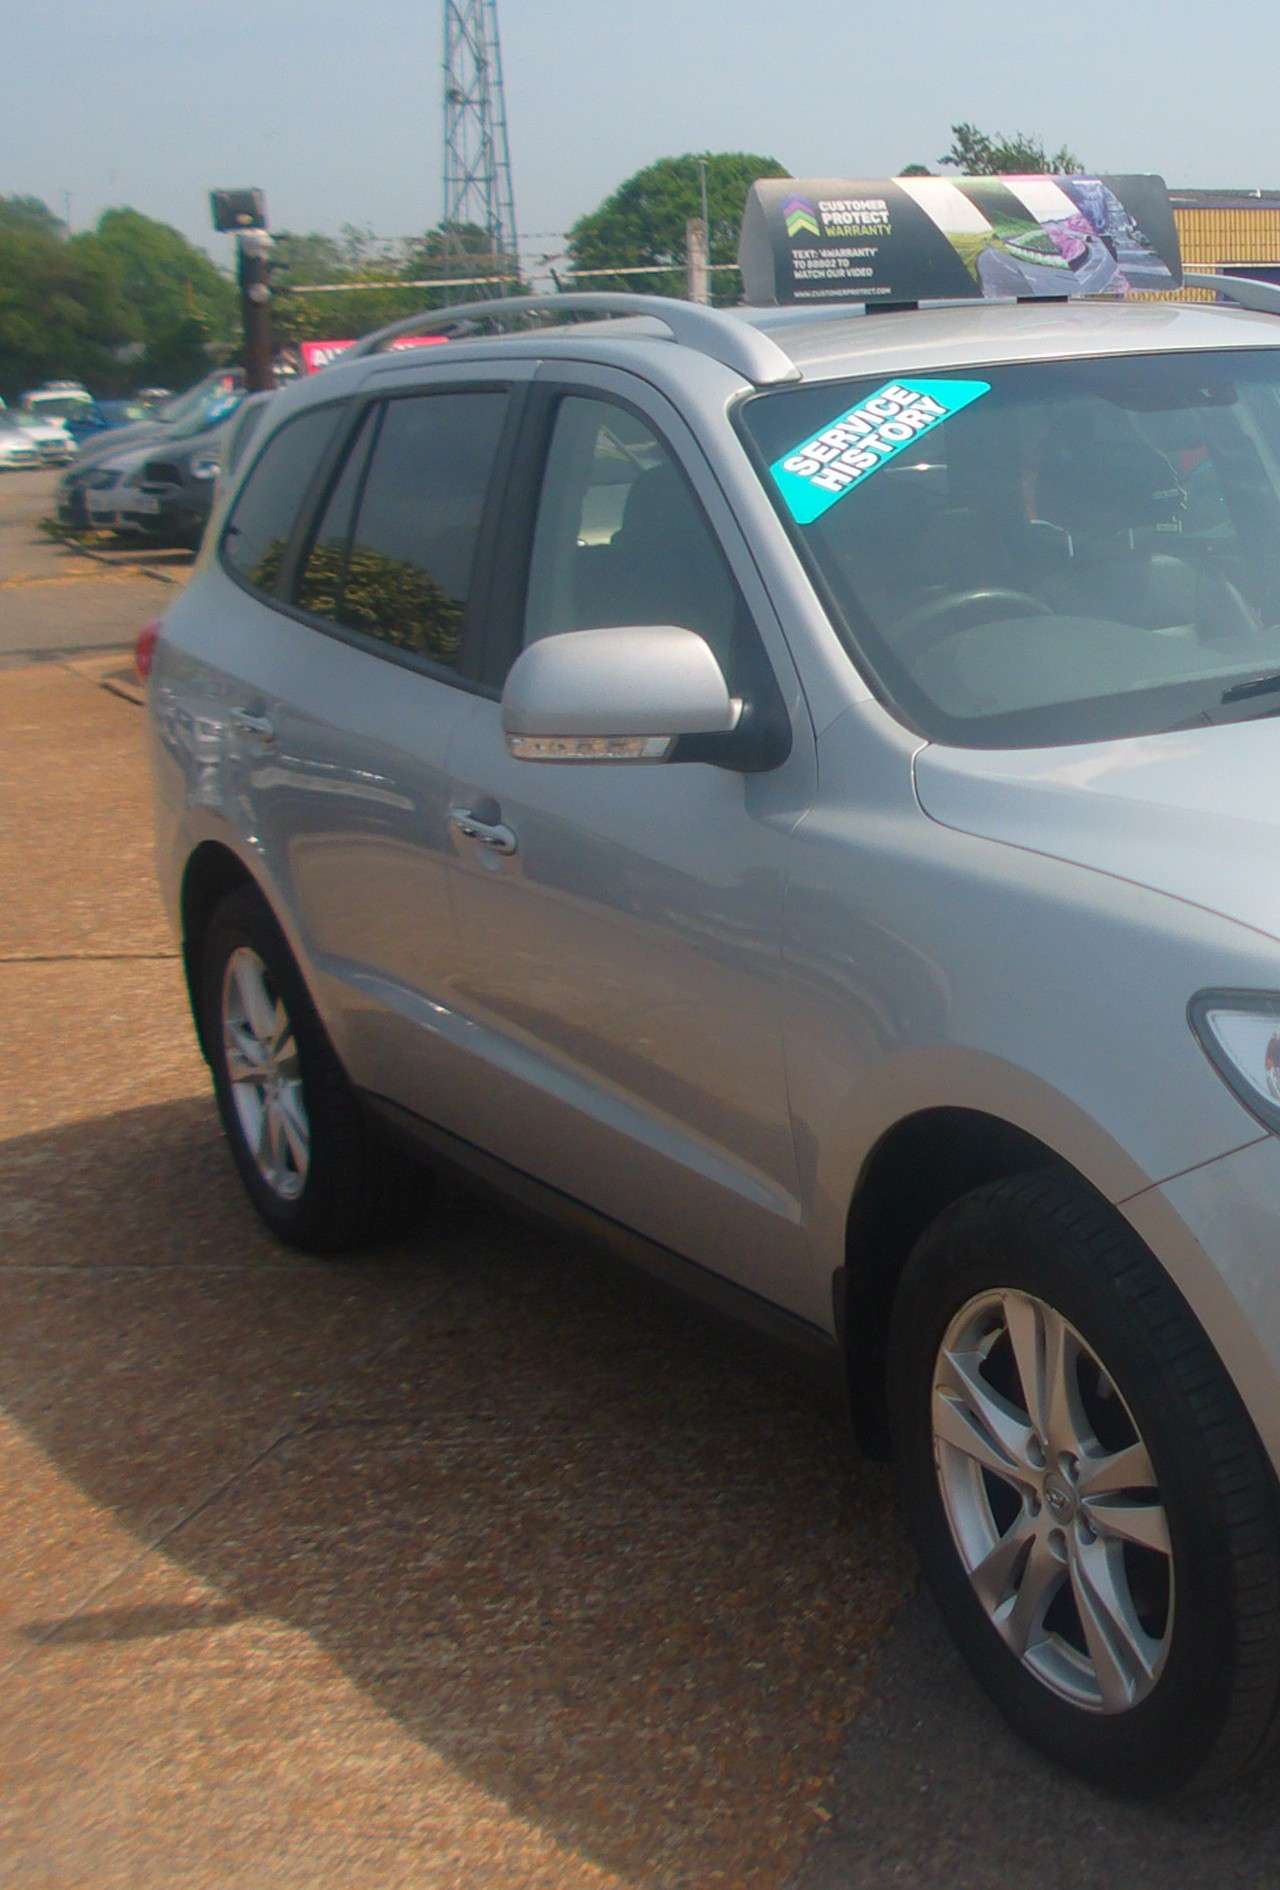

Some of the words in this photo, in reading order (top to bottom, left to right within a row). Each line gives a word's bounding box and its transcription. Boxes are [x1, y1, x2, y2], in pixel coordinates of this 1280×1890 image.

[818, 199, 887, 212] CUSTOMER
[821, 211, 889, 225] PROTECT
[825, 224, 891, 237] WARRANTY
[793, 260, 806, 269] TO
[838, 258, 850, 268] TO
[794, 269, 825, 279] WATCH
[826, 268, 845, 278] OUR
[847, 267, 874, 277] VIDEO
[783, 385, 921, 477] SERVICE
[810, 395, 949, 493] HISTORY
